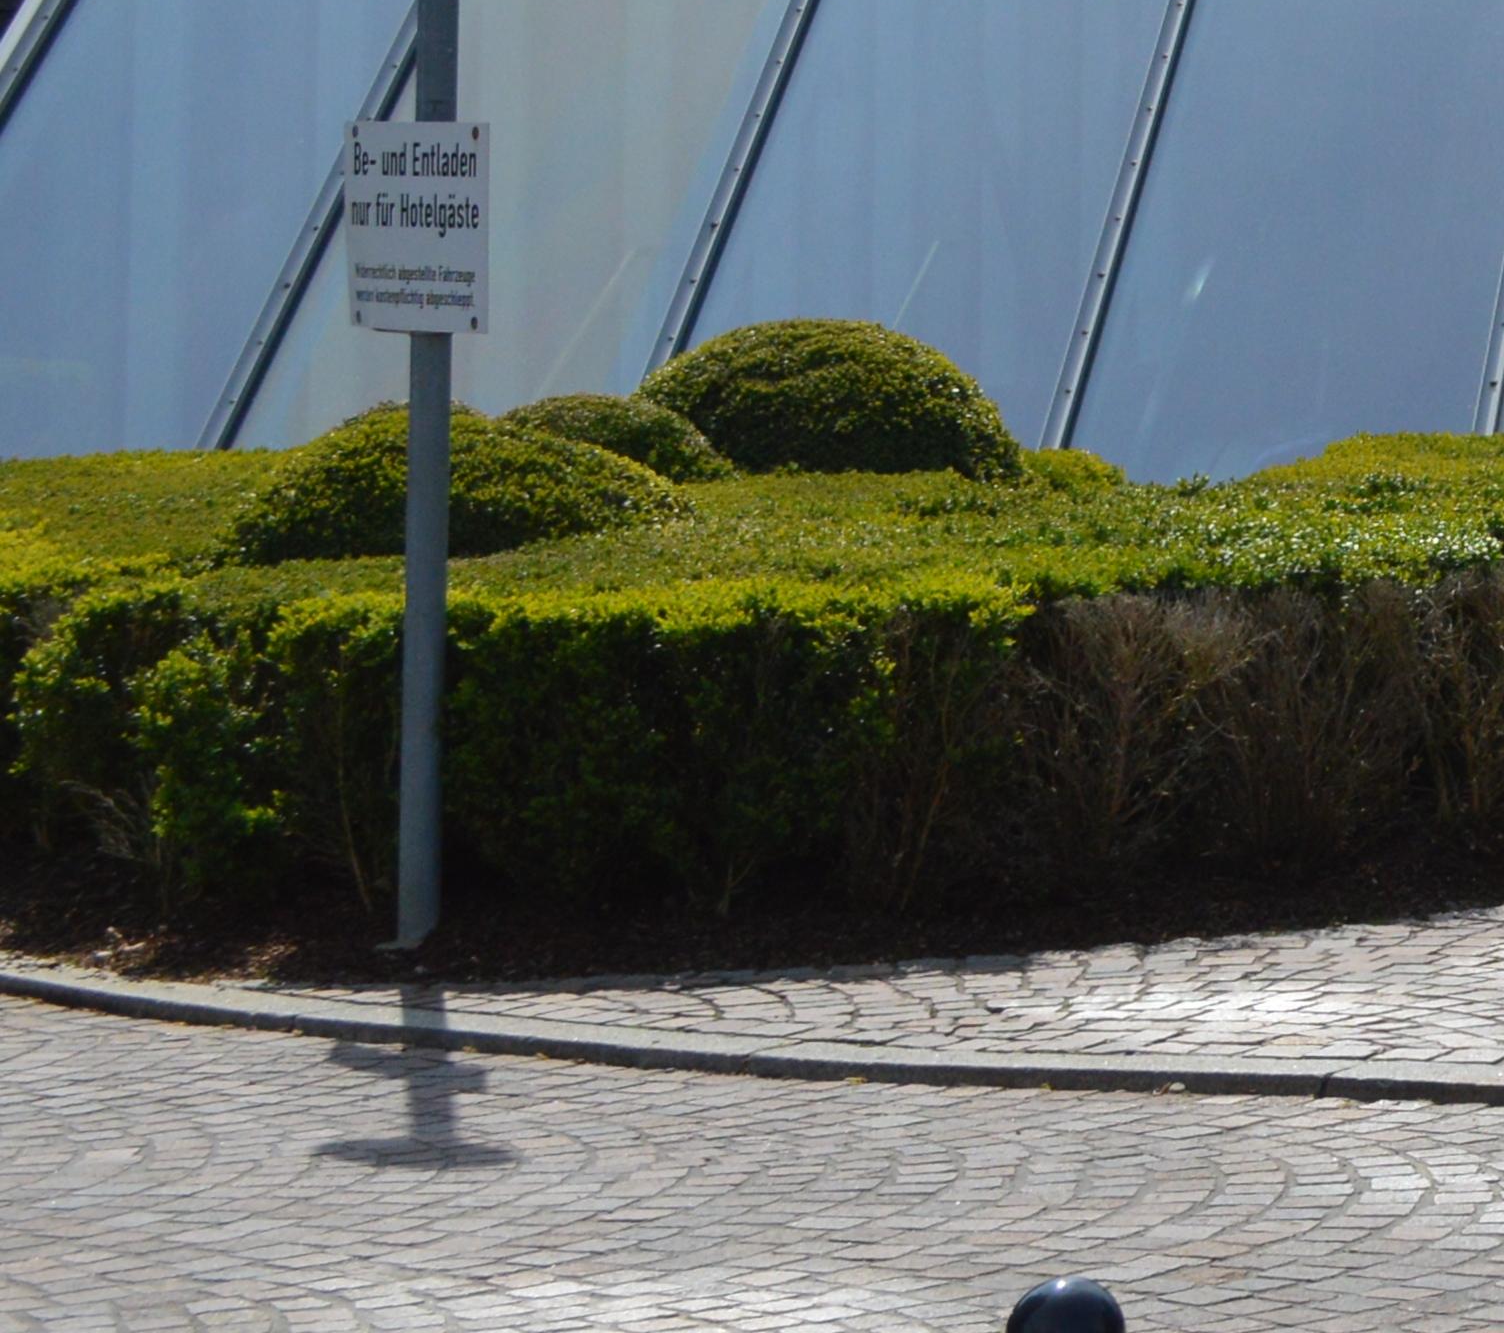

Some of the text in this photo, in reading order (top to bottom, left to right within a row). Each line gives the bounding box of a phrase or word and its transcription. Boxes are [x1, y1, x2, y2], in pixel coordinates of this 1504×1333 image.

[353, 141, 477, 177] Be- und Entladen
[351, 192, 480, 238] nur für Hotelgäste
